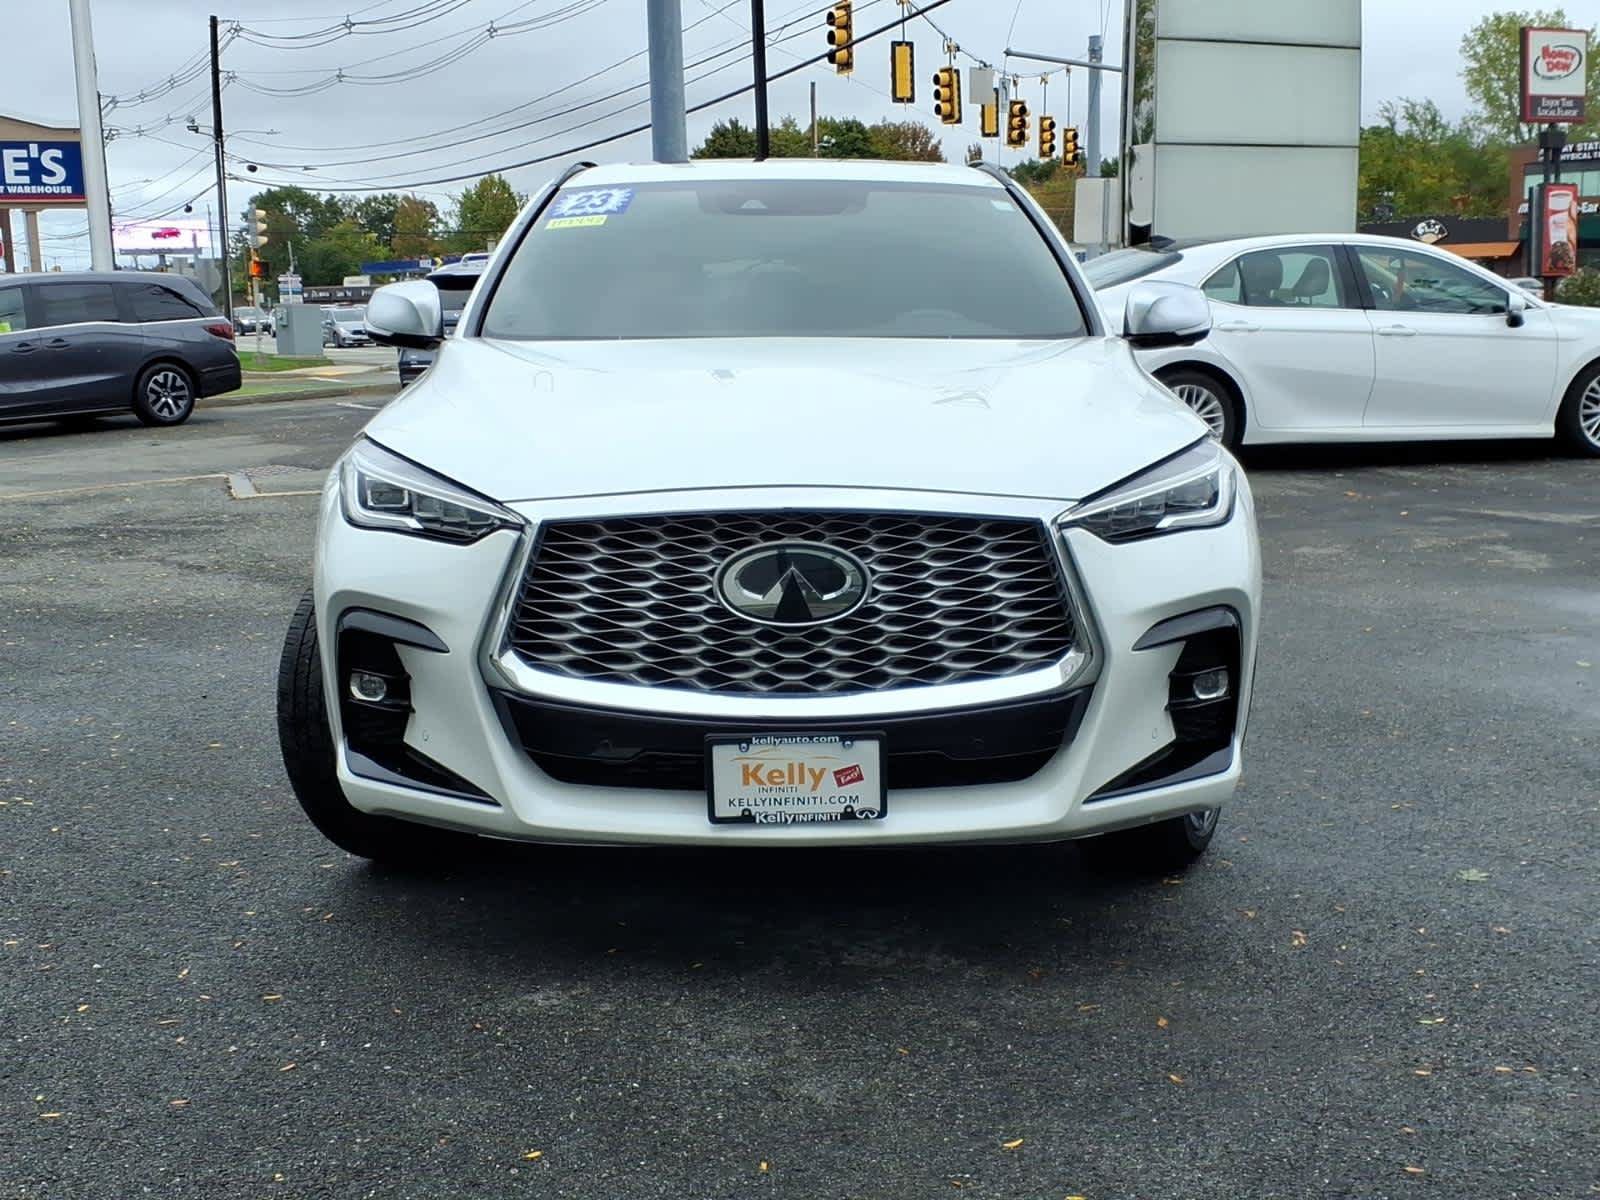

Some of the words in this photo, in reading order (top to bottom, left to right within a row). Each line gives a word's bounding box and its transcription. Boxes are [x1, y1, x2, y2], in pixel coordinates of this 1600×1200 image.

[1576, 141, 1600, 151] STAT
[7, 185, 72, 194] WAREHOUSE
[751, 735, 840, 747] kellyauto.com
[741, 762, 827, 792] Kelly
[758, 785, 798, 794] INFINITI
[728, 794, 860, 807] KELLYINFINITI.COM
